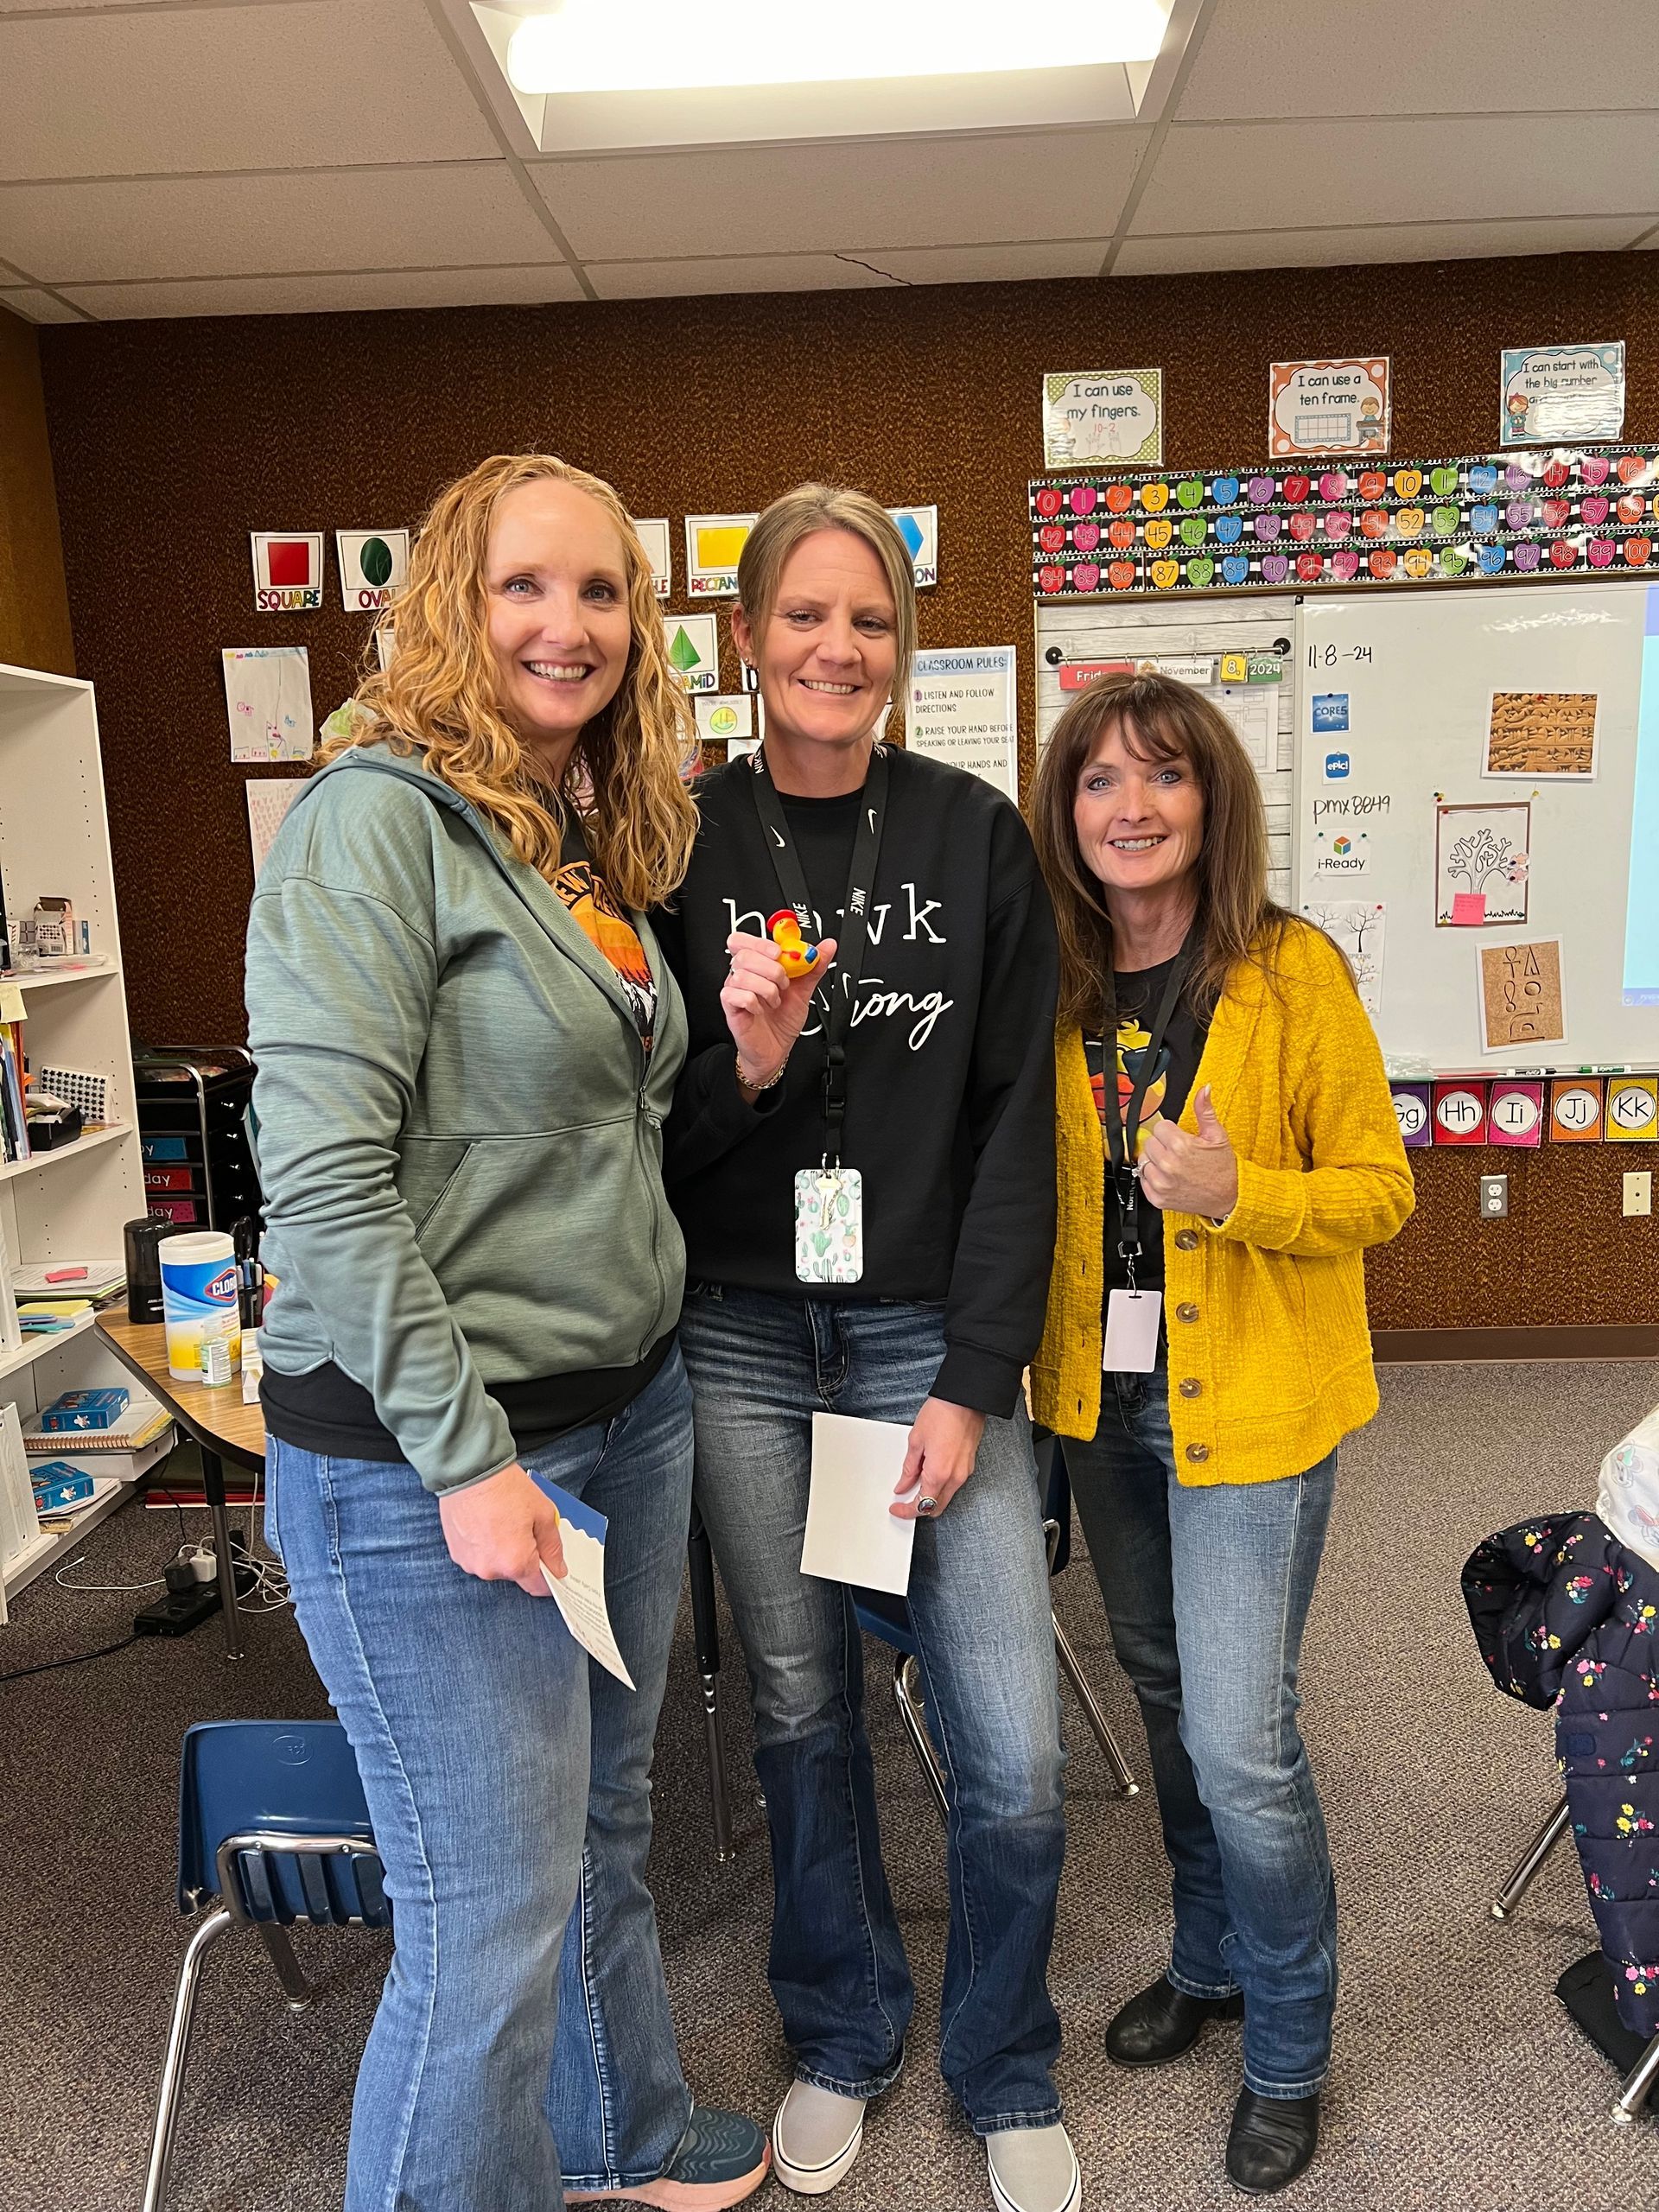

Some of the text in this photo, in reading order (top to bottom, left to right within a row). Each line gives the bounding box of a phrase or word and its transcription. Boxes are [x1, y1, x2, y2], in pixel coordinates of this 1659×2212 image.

[1523, 359, 1599, 373] I can start with
[1298, 375, 1361, 387] I can use a
[1525, 378, 1541, 389] the
[1544, 376, 1558, 389] big
[1073, 385, 1133, 397] I can use
[1300, 392, 1360, 405] ten frame.
[1067, 404, 1141, 422] my fingers.
[1043, 494, 1055, 511] 0
[1081, 493, 1086, 509] 1
[1115, 490, 1124, 508] 2
[1150, 490, 1160, 505] 3
[1185, 486, 1196, 503] 4
[1220, 484, 1232, 499] 5
[1255, 481, 1267, 498] 6
[1292, 480, 1303, 498] 7
[1328, 478, 1338, 495] 8
[1366, 478, 1377, 493] 9
[1402, 476, 1416, 492] 10
[1442, 474, 1447, 489] 11
[1477, 470, 1491, 487] 12
[1588, 463, 1602, 479] 15
[1625, 462, 1638, 478] 16
[1041, 530, 1063, 548] 42
[1076, 529, 1097, 546] 43
[1112, 527, 1132, 543] 44
[1148, 525, 1168, 542] 45
[1184, 524, 1204, 540] 46
[1220, 522, 1239, 538] 47
[1257, 519, 1278, 536] 48
[1292, 518, 1313, 535] 49
[1327, 517, 1350, 533] 50
[1367, 515, 1381, 531] 51
[1401, 513, 1421, 530] 52
[1437, 512, 1456, 528] 53
[1473, 510, 1494, 525] 54
[1509, 506, 1529, 524] 55
[1546, 504, 1567, 521] 56
[1585, 502, 1606, 518] 57
[1042, 570, 1062, 588] 84
[1077, 569, 1096, 585] 85
[1112, 566, 1132, 582] 86
[1156, 566, 1175, 581] 87
[1191, 563, 1211, 579] 88
[1225, 562, 1246, 579] 89
[1264, 560, 1284, 576] 90
[1300, 557, 1314, 574] 91
[1334, 556, 1355, 573] 92
[1372, 556, 1392, 571] 93
[1443, 553, 1464, 568] 95
[1481, 550, 1501, 566] 96
[1517, 547, 1538, 565] 97
[1553, 545, 1573, 562] 98
[1590, 544, 1612, 561] 99
[1626, 543, 1650, 558] 100
[257, 589, 321, 612] SQUARE
[918, 658, 974, 671] CLASSROOM
[1160, 665, 1210, 675] November
[1249, 663, 1281, 675] 2024
[924, 690, 947, 700] LISTEN
[949, 690, 963, 698] AND
[965, 689, 995, 698] FOLLOW
[916, 704, 957, 714] DIRECTIONS
[925, 726, 945, 735] RAISE
[947, 725, 967, 734] YOUR
[969, 724, 988, 734] HAND
[916, 739, 946, 747] SPEAKING
[947, 738, 957, 747] OR
[957, 736, 982, 746] LEAVING
[982, 736, 1000, 745] YOUR
[967, 760, 991, 769] HANDS
[993, 759, 1007, 768] AND
[1327, 760, 1348, 771] epic!
[1318, 858, 1365, 871] i-Ready
[850, 887, 867, 917] NIKE
[792, 902, 812, 929] NIKE
[1445, 1100, 1476, 1122] Hh
[1565, 1097, 1587, 1124] Jj
[1618, 1096, 1649, 1118] Kk
